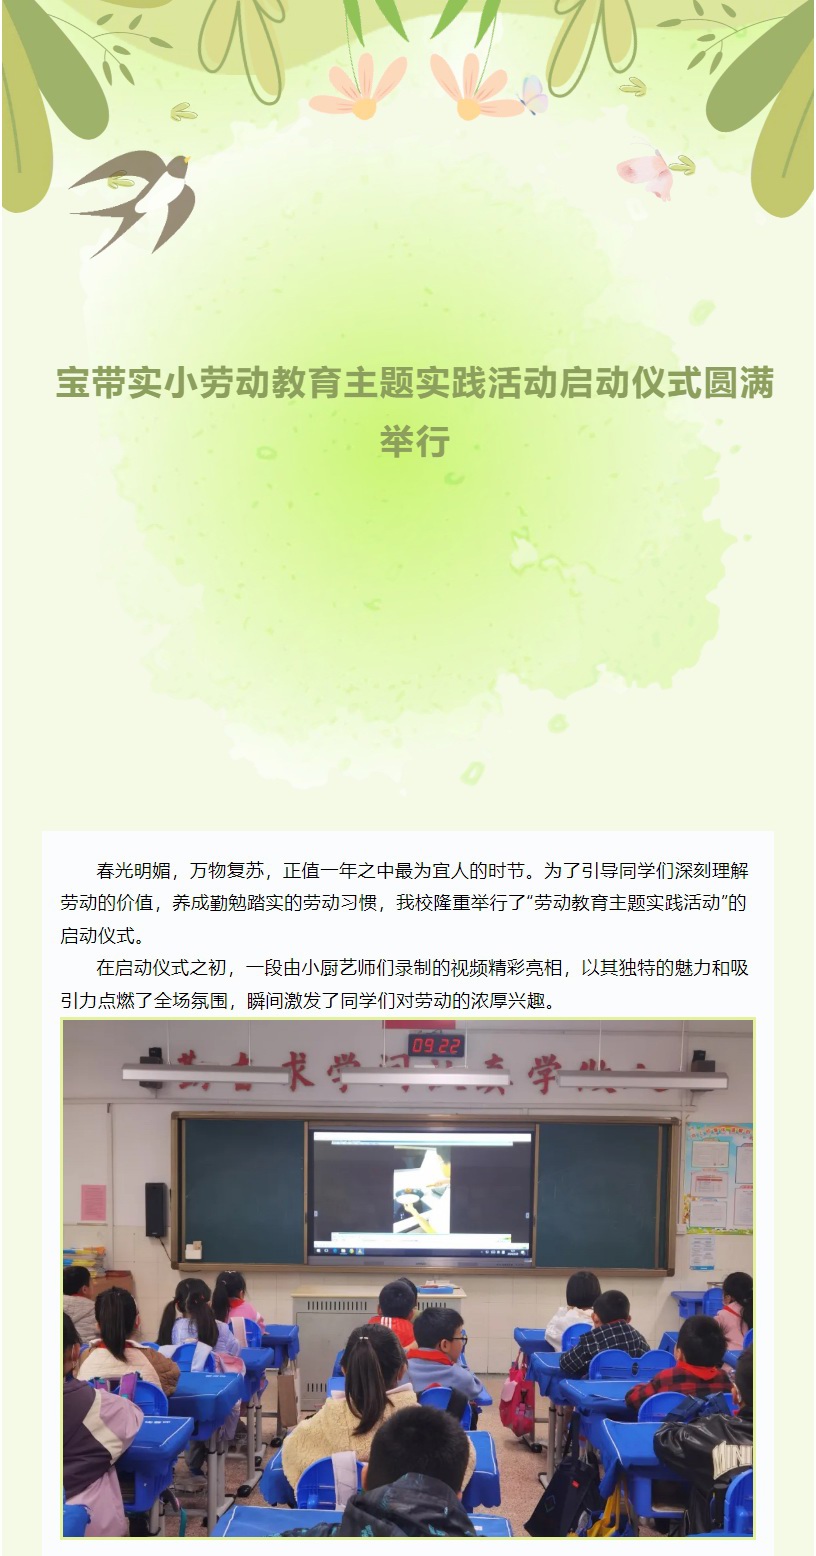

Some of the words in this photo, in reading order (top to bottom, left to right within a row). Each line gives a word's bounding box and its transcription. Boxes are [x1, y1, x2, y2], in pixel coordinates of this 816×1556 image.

[56, 365, 774, 400] 宝带实小劳动教育主题实践活动启动仪式圆满
[380, 425, 450, 459] 举行
[96, 860, 749, 881] 春光明媚，万物复苏，正值一年之中最为宜人的时节。为了引导同学们深刻理解
[60, 926, 143, 945] 启动仪式。
[96, 957, 749, 978] 在启动仪式之初，一段由小厨艺师们录制的视频精彩亮相，以其独特的魅力和吸
[61, 991, 553, 1011] 引力点燃了全场氛围，瞬间激发了同学们对劳动的浓厚兴趣。
